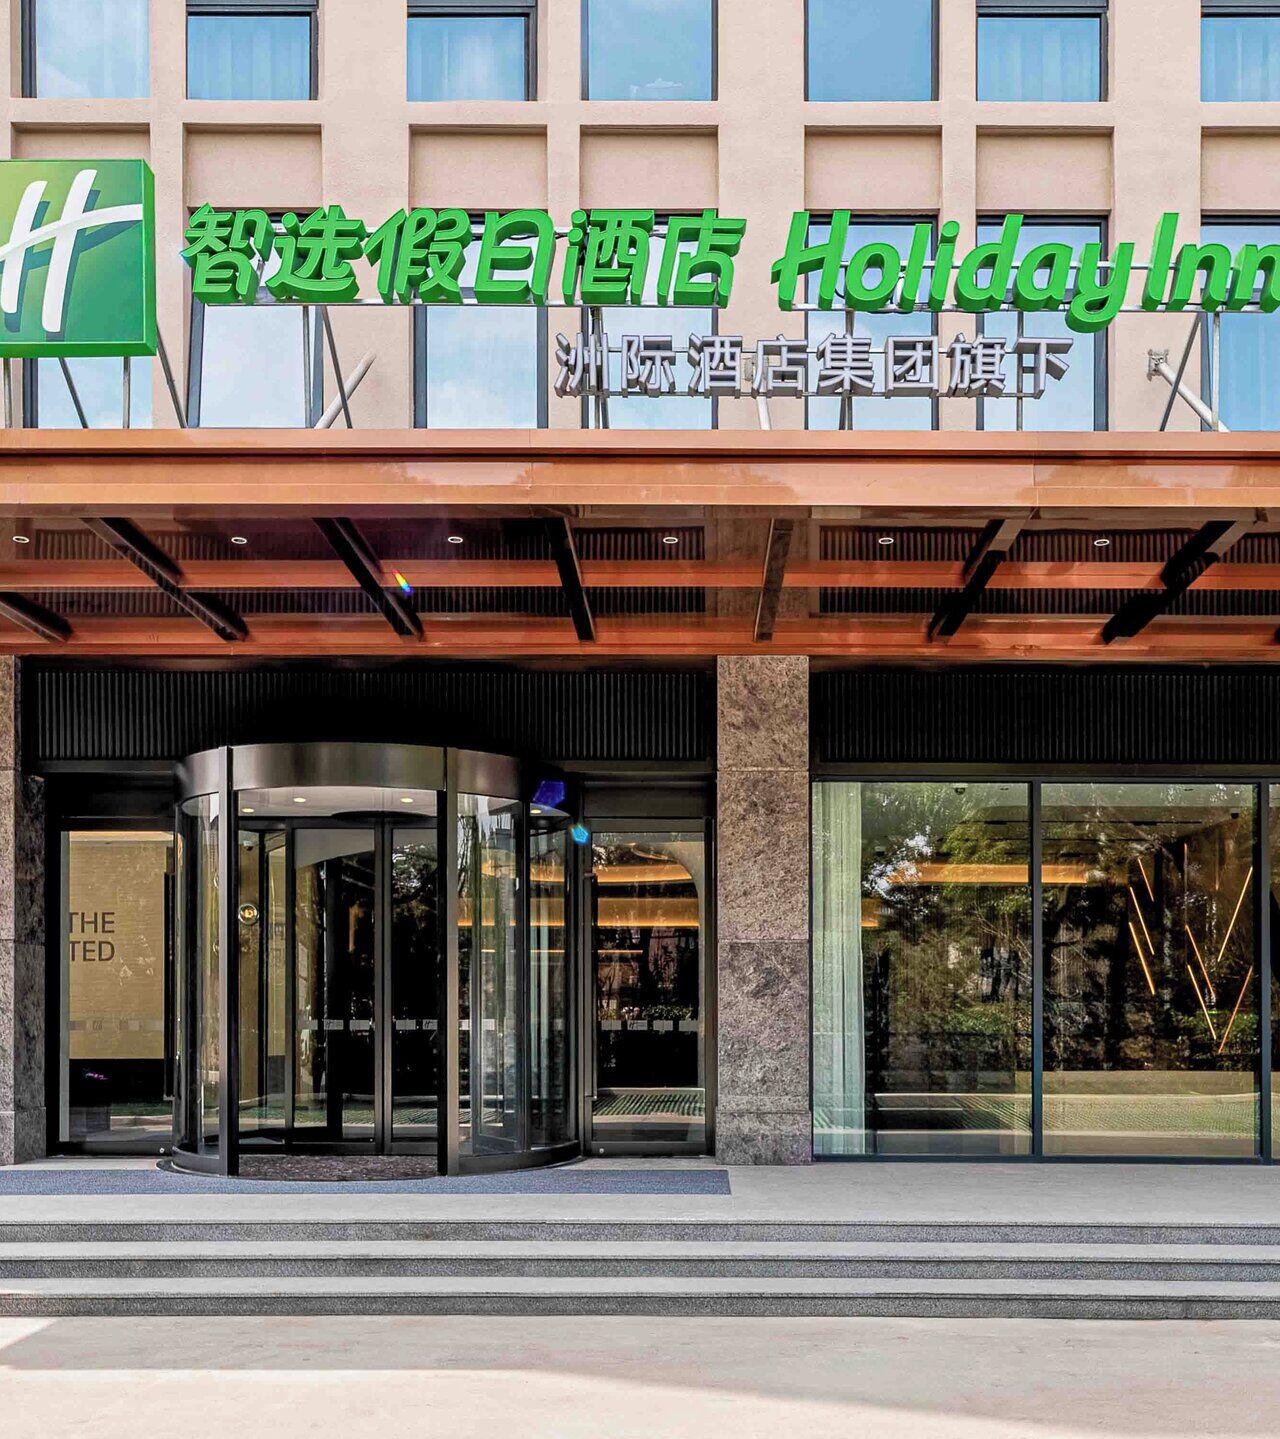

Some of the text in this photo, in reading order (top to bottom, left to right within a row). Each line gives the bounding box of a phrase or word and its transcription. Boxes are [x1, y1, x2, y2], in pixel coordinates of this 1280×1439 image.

[181, 202, 747, 308] 智选假日酒店
[771, 210, 1135, 333] Holiday
[555, 332, 1074, 399] 洲际酒店集团旗下
